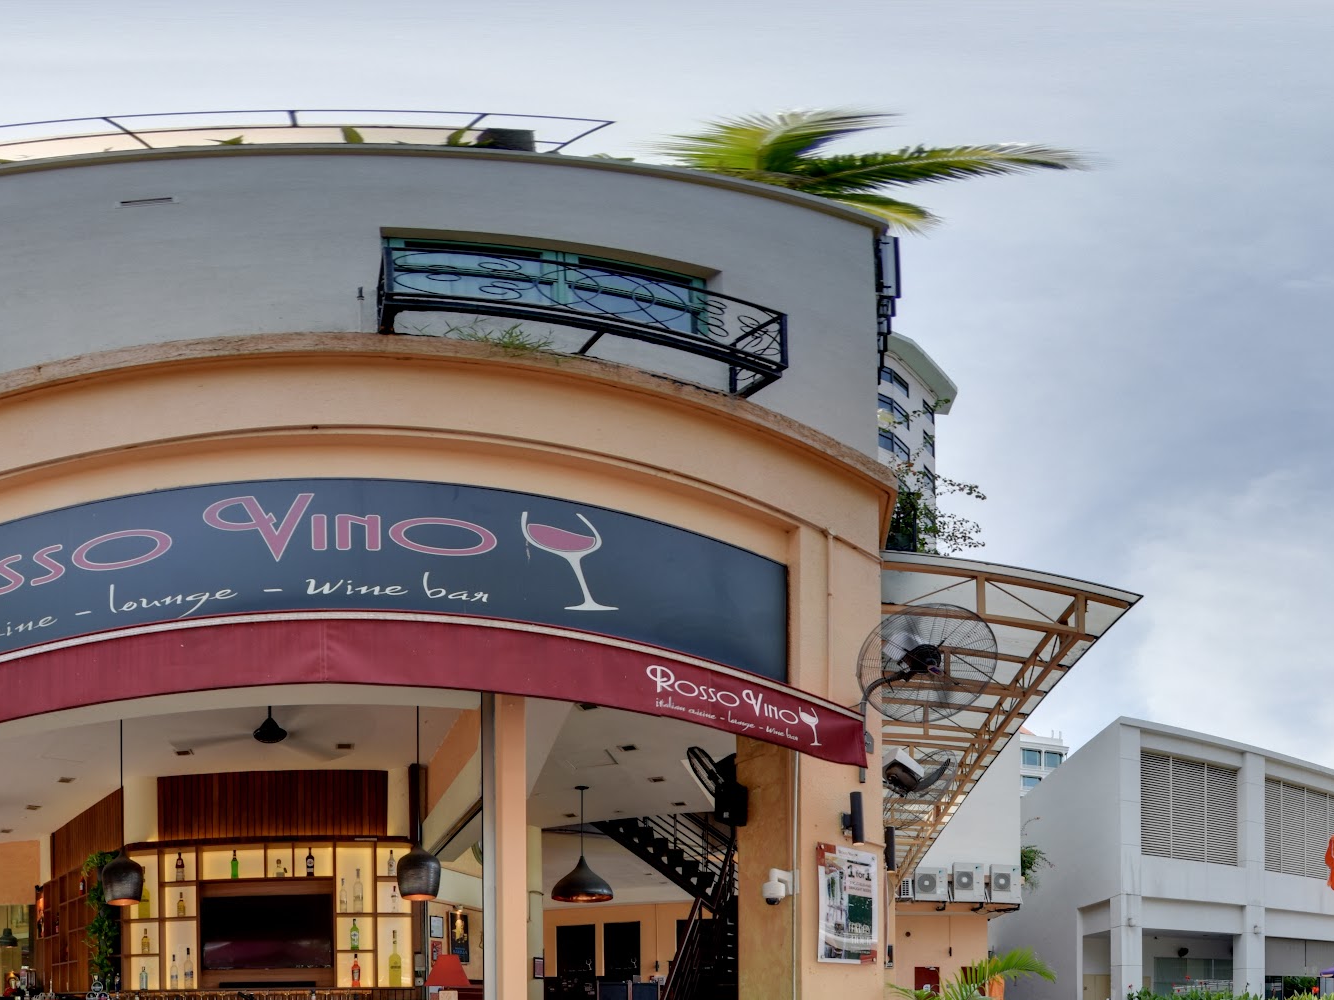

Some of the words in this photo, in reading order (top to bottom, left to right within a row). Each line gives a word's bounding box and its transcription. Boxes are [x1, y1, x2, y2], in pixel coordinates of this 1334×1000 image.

[109, 584, 238, 619] lounge
[423, 571, 489, 603] bar
[855, 870, 865, 880] for
